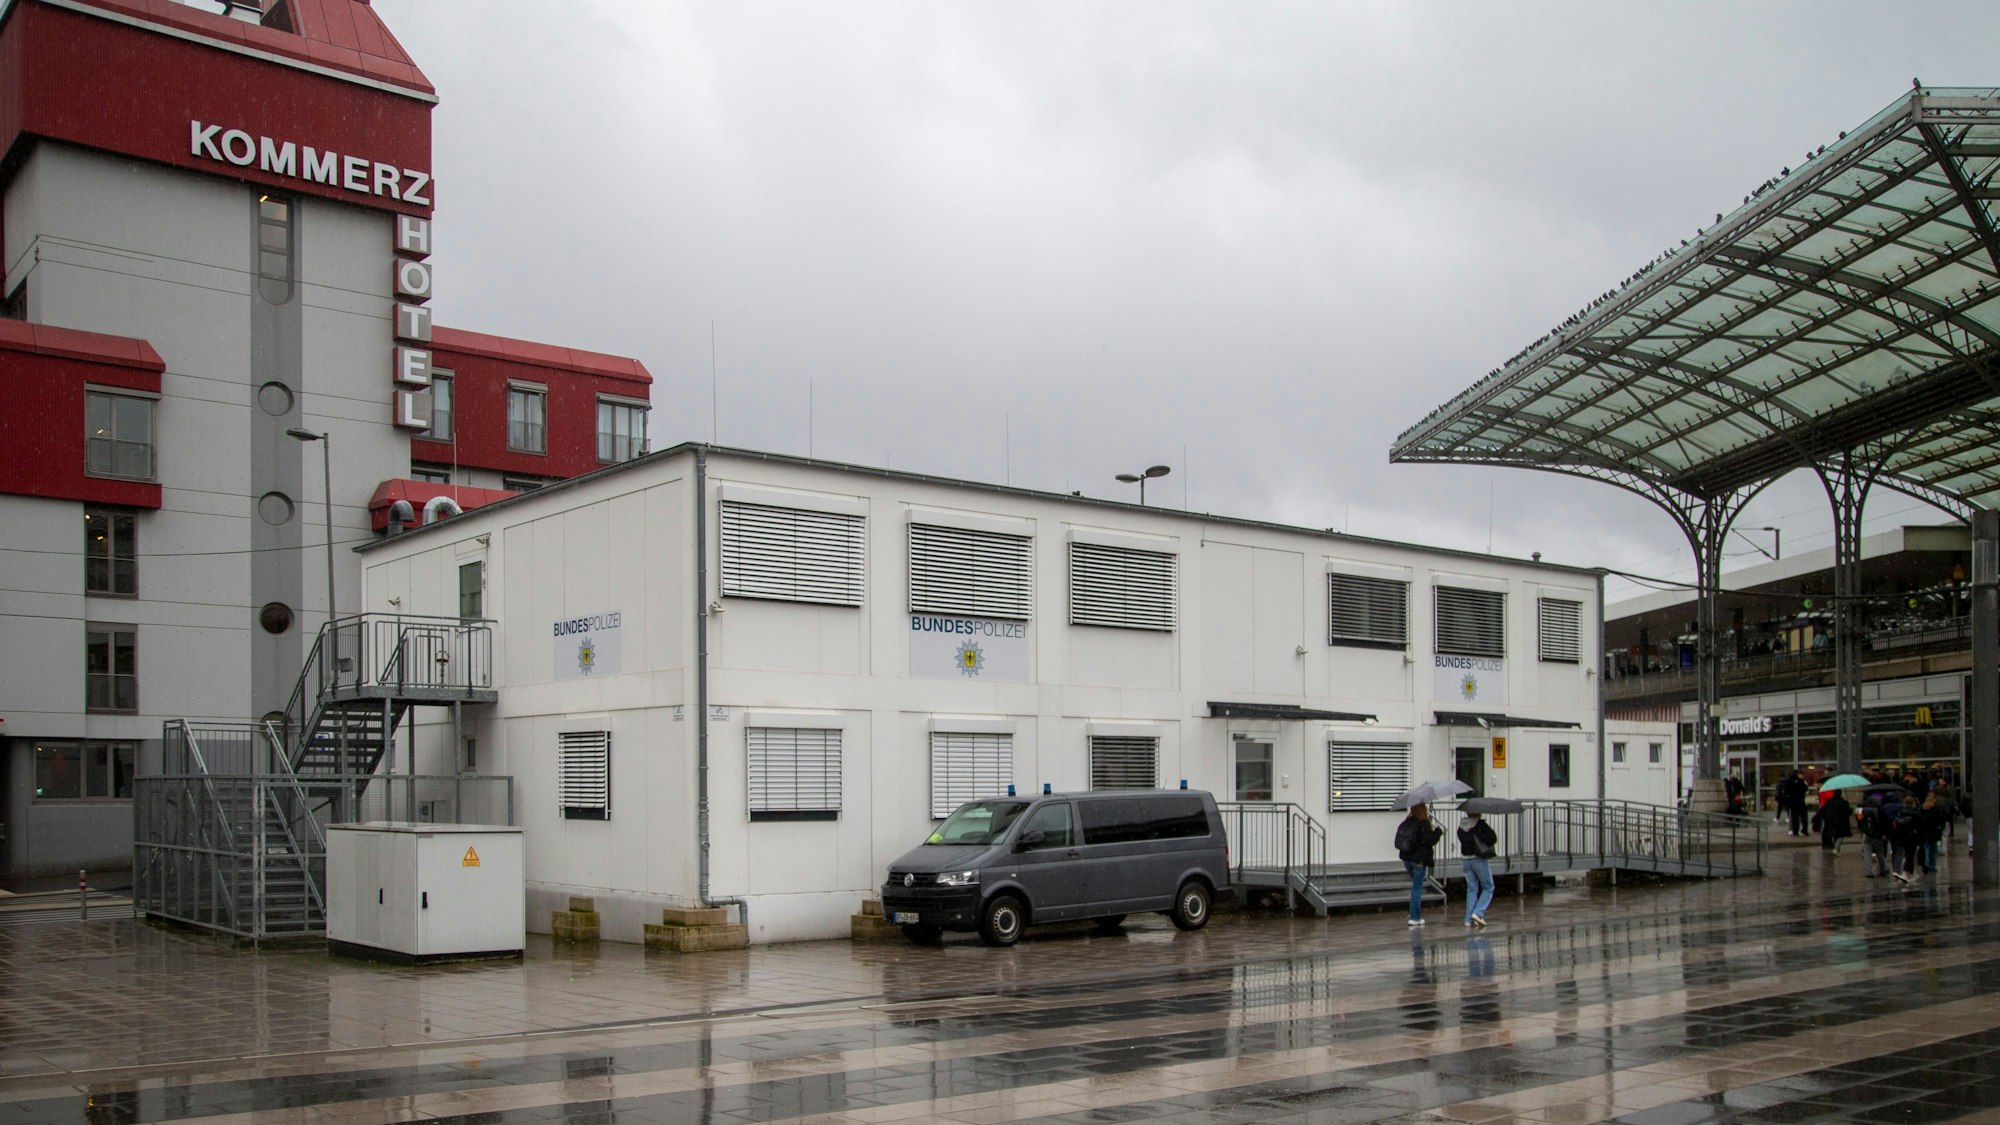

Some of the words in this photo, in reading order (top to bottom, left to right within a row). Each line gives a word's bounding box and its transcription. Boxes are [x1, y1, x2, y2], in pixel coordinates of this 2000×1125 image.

[191, 120, 430, 206] KOMMERZ
[401, 217, 430, 426] HOTEL
[554, 613, 621, 637] BUNDESPOLIZEI
[912, 616, 1026, 639] BUNDESPOLIZEI
[1435, 656, 1503, 672] BUNDESPOLIZEI
[1703, 717, 1772, 736] Donald's
